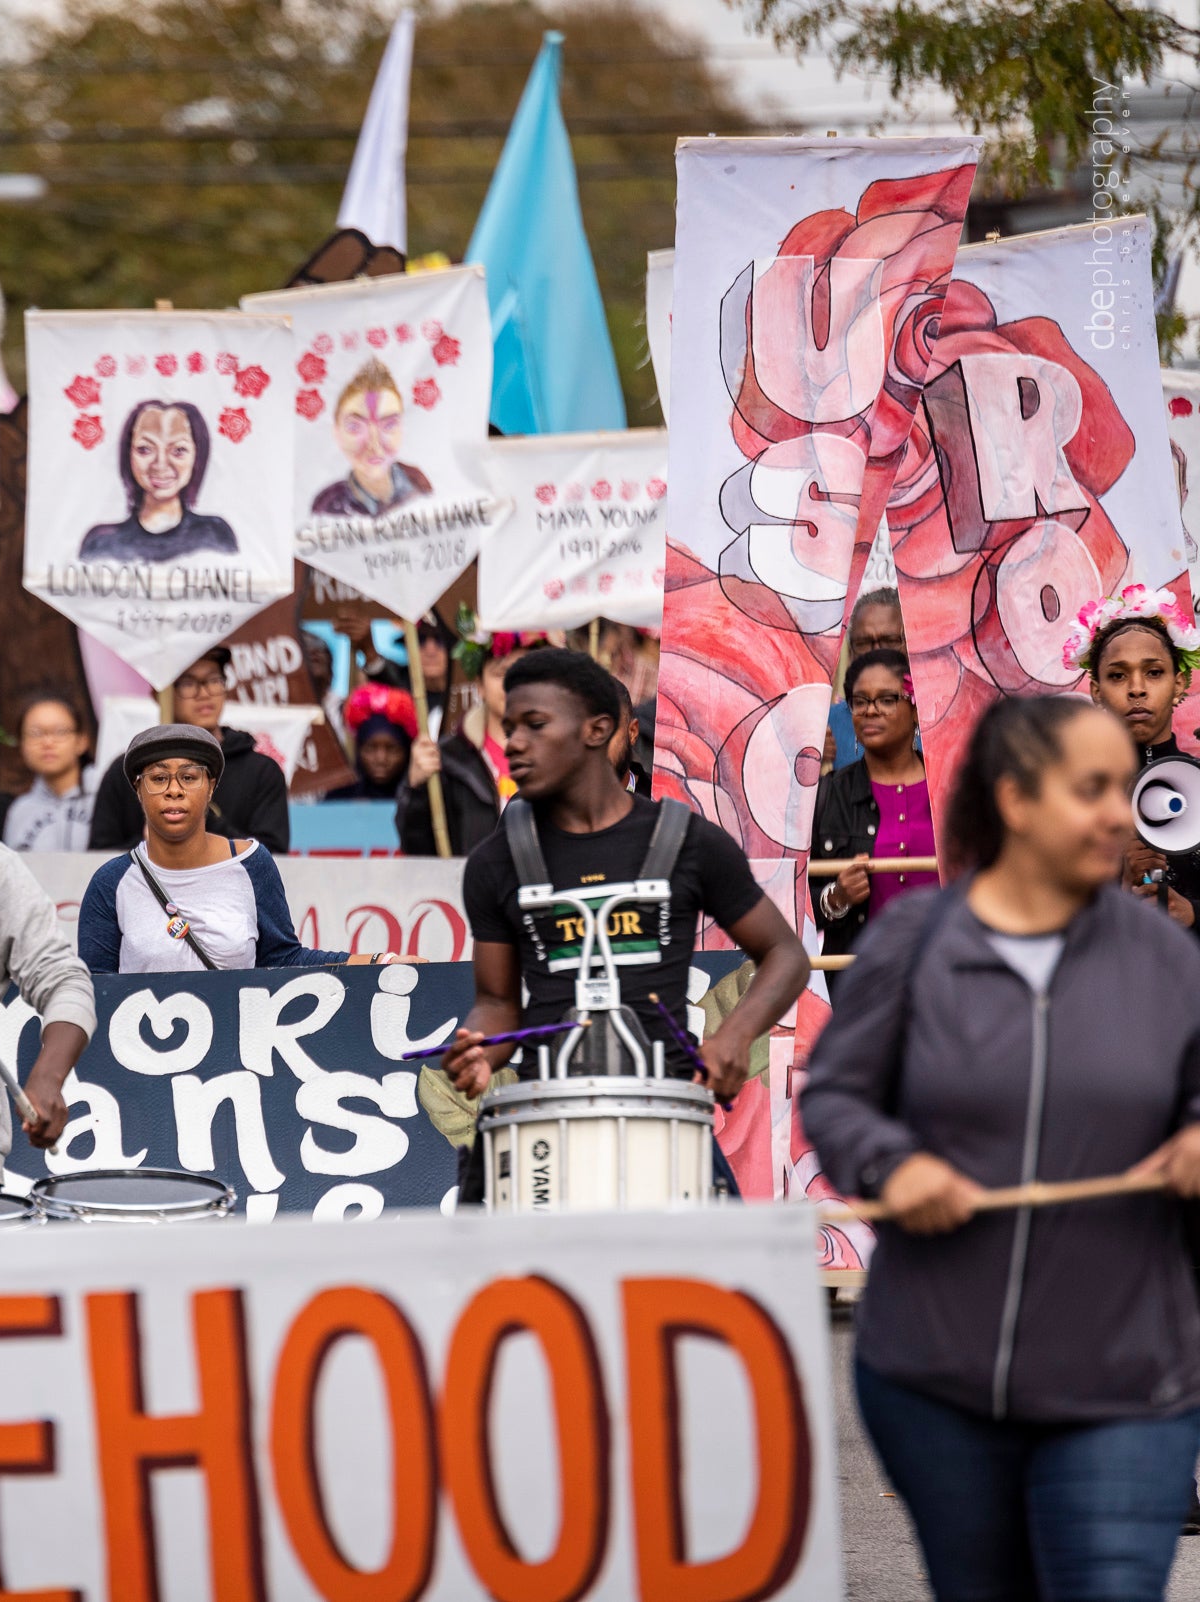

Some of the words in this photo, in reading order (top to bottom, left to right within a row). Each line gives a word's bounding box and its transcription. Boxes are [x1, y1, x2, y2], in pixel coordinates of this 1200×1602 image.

[295, 520, 368, 557] SEAN
[371, 512, 431, 544] RYAN
[434, 498, 494, 535] HAKE
[536, 508, 593, 532] MAYA
[598, 506, 659, 530] YOUNG
[48, 562, 152, 600] LONDON
[167, 565, 262, 604] CHANEL
